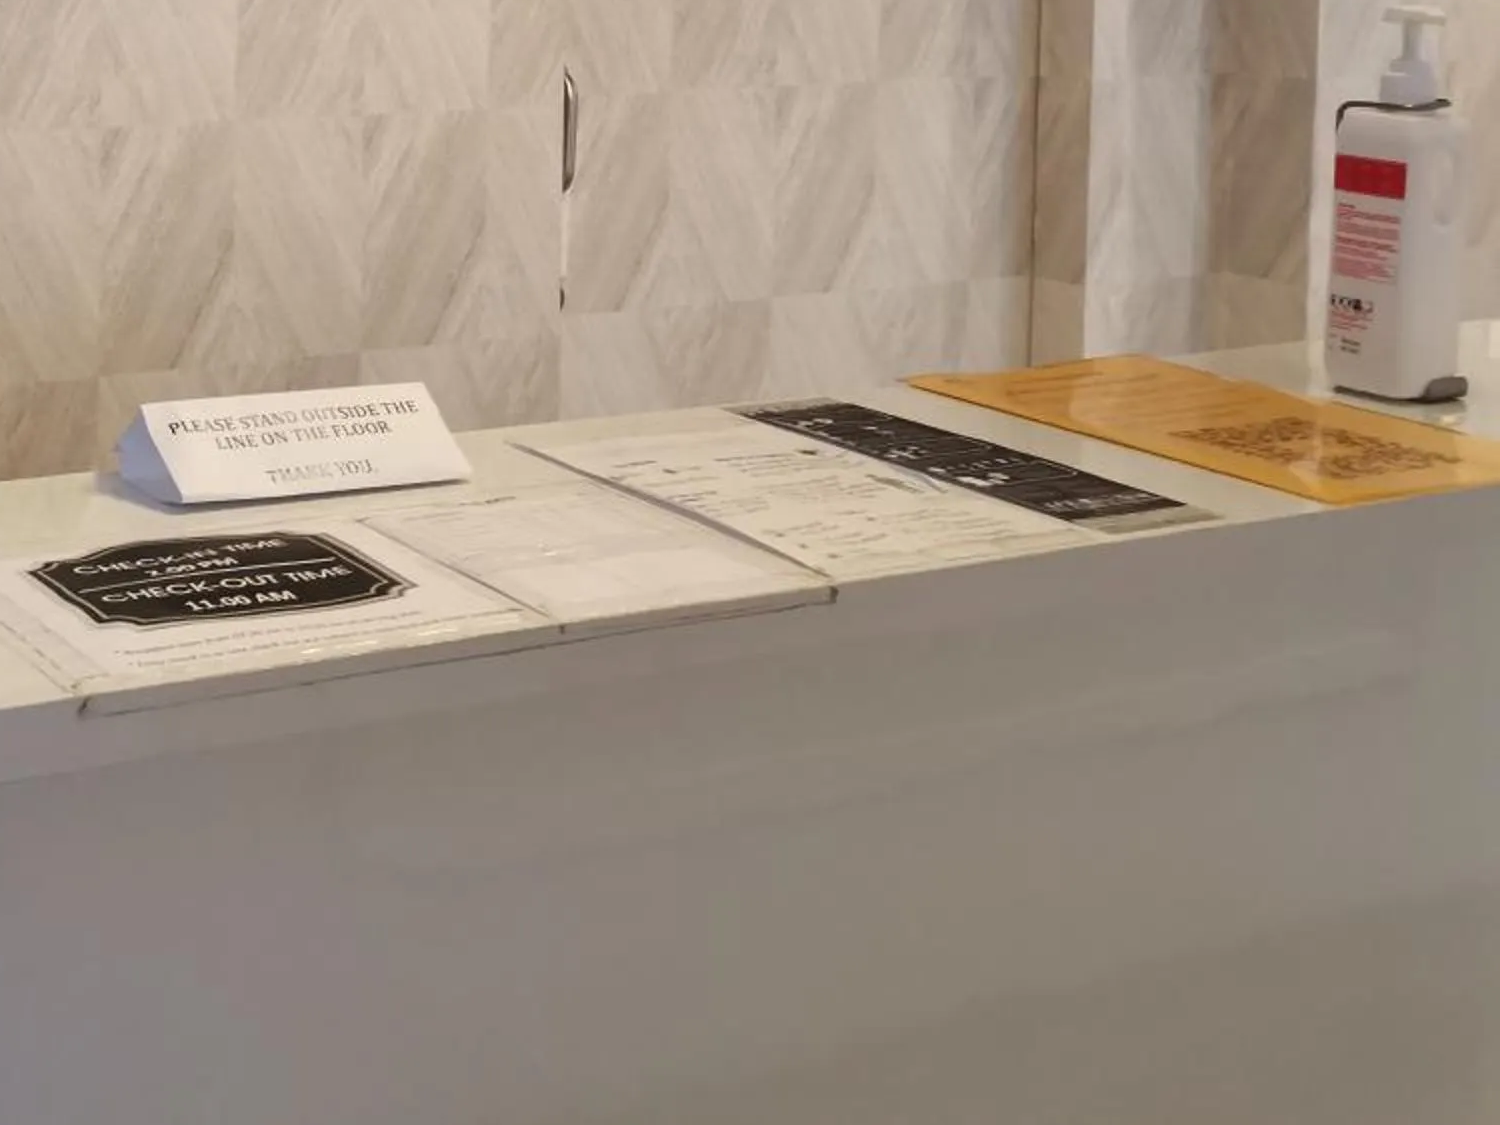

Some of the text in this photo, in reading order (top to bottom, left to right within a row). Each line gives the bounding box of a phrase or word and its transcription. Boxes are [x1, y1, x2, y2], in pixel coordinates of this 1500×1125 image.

[168, 399, 419, 435] PLEASE STAND OUTSIDE THE
[215, 420, 393, 451] LINE ON THE FLOOR
[197, 557, 239, 569] PM
[101, 565, 352, 603] CHECK-OUT TIME
[255, 589, 297, 605] AM
